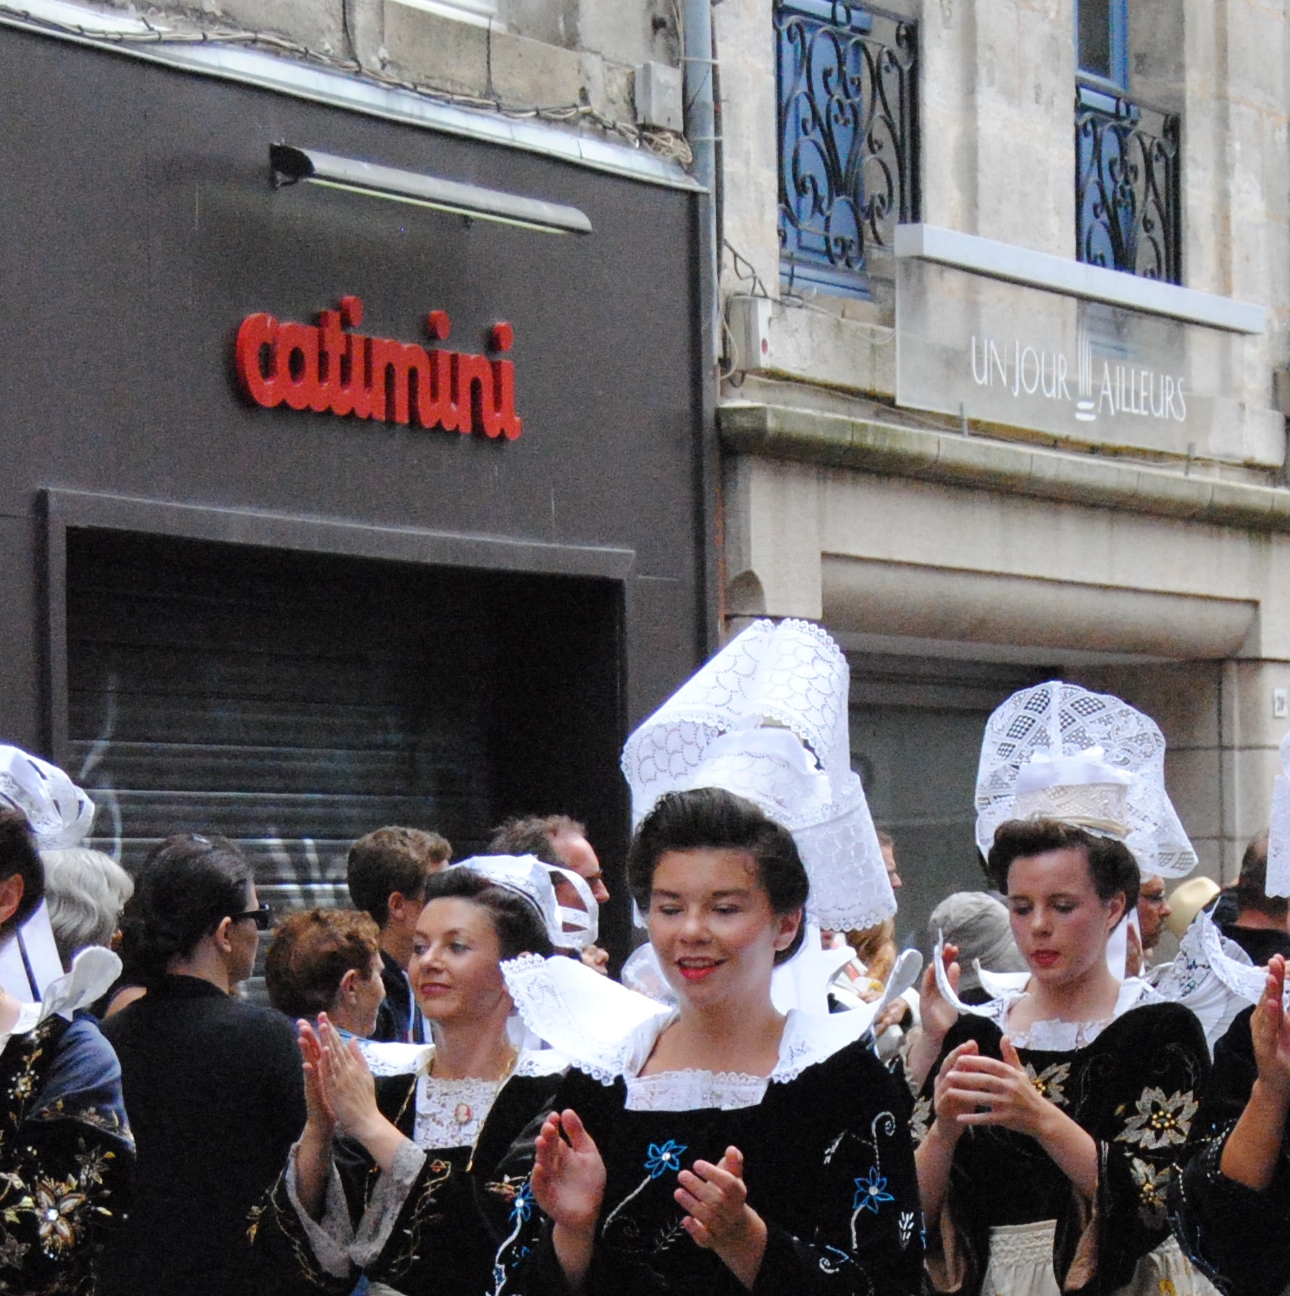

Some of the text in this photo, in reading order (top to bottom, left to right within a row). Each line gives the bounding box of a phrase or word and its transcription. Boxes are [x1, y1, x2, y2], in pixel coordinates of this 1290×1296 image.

[236, 296, 522, 440] catimini
[971, 335, 1187, 423] UN JOUR AILLEURS
